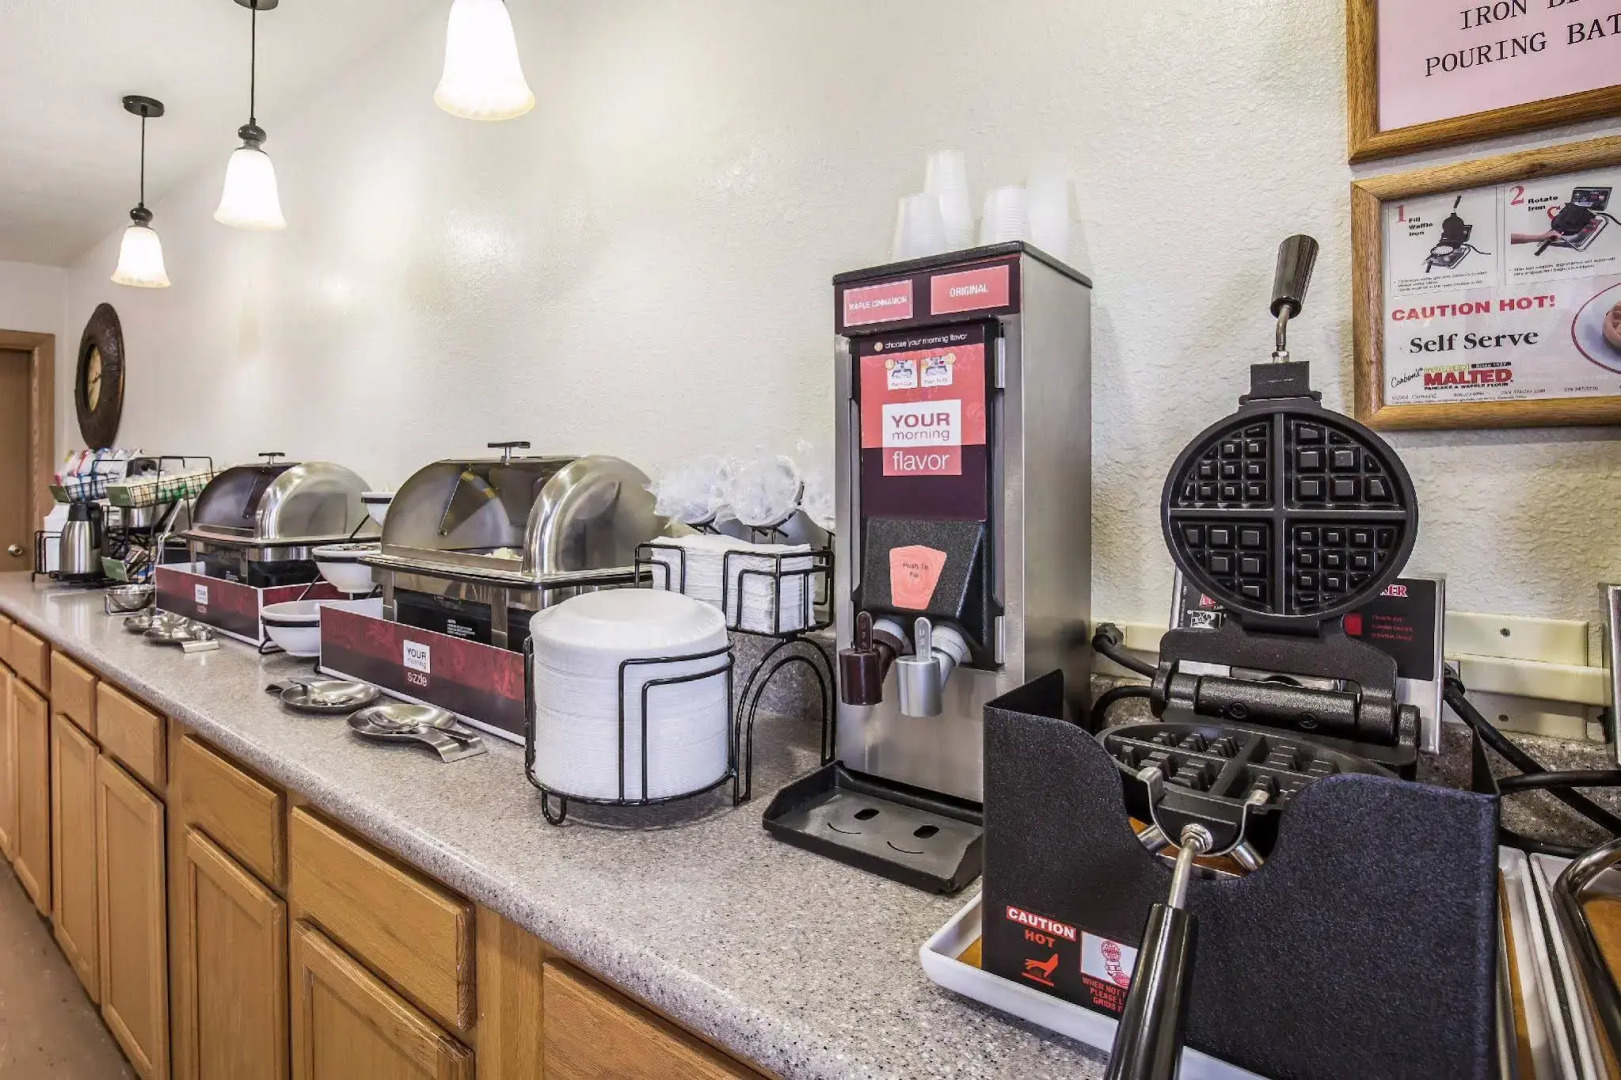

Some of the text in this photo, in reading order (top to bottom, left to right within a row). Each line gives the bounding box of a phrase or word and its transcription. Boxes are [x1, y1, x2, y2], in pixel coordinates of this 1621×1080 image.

[1459, 0, 1527, 30] IRON
[1425, 31, 1547, 77] POURING
[1510, 186, 1525, 205] 2
[1528, 196, 1558, 204] Rotate
[1395, 205, 1407, 223] 1
[950, 283, 988, 298] ORIGINAL
[849, 296, 907, 311] MAPLE CINNAMON
[1392, 295, 1555, 321] CAUTION HOT!
[885, 341, 907, 349] choose
[908, 338, 921, 347] your
[923, 336, 949, 344] morning
[1410, 331, 1539, 354] Self Serve
[1424, 368, 1512, 386] MALTED
[891, 413, 950, 428] YOUR
[892, 429, 950, 441] morning
[892, 450, 950, 470] flavor
[407, 647, 426, 660] YOUR
[408, 672, 427, 686] sizzle
[1008, 907, 1075, 939] CAUTION
[1024, 929, 1056, 947] HOT
[1082, 976, 1105, 989] WHEN
[1106, 985, 1120, 995] NOT
[1090, 987, 1117, 1002] PLEASE
